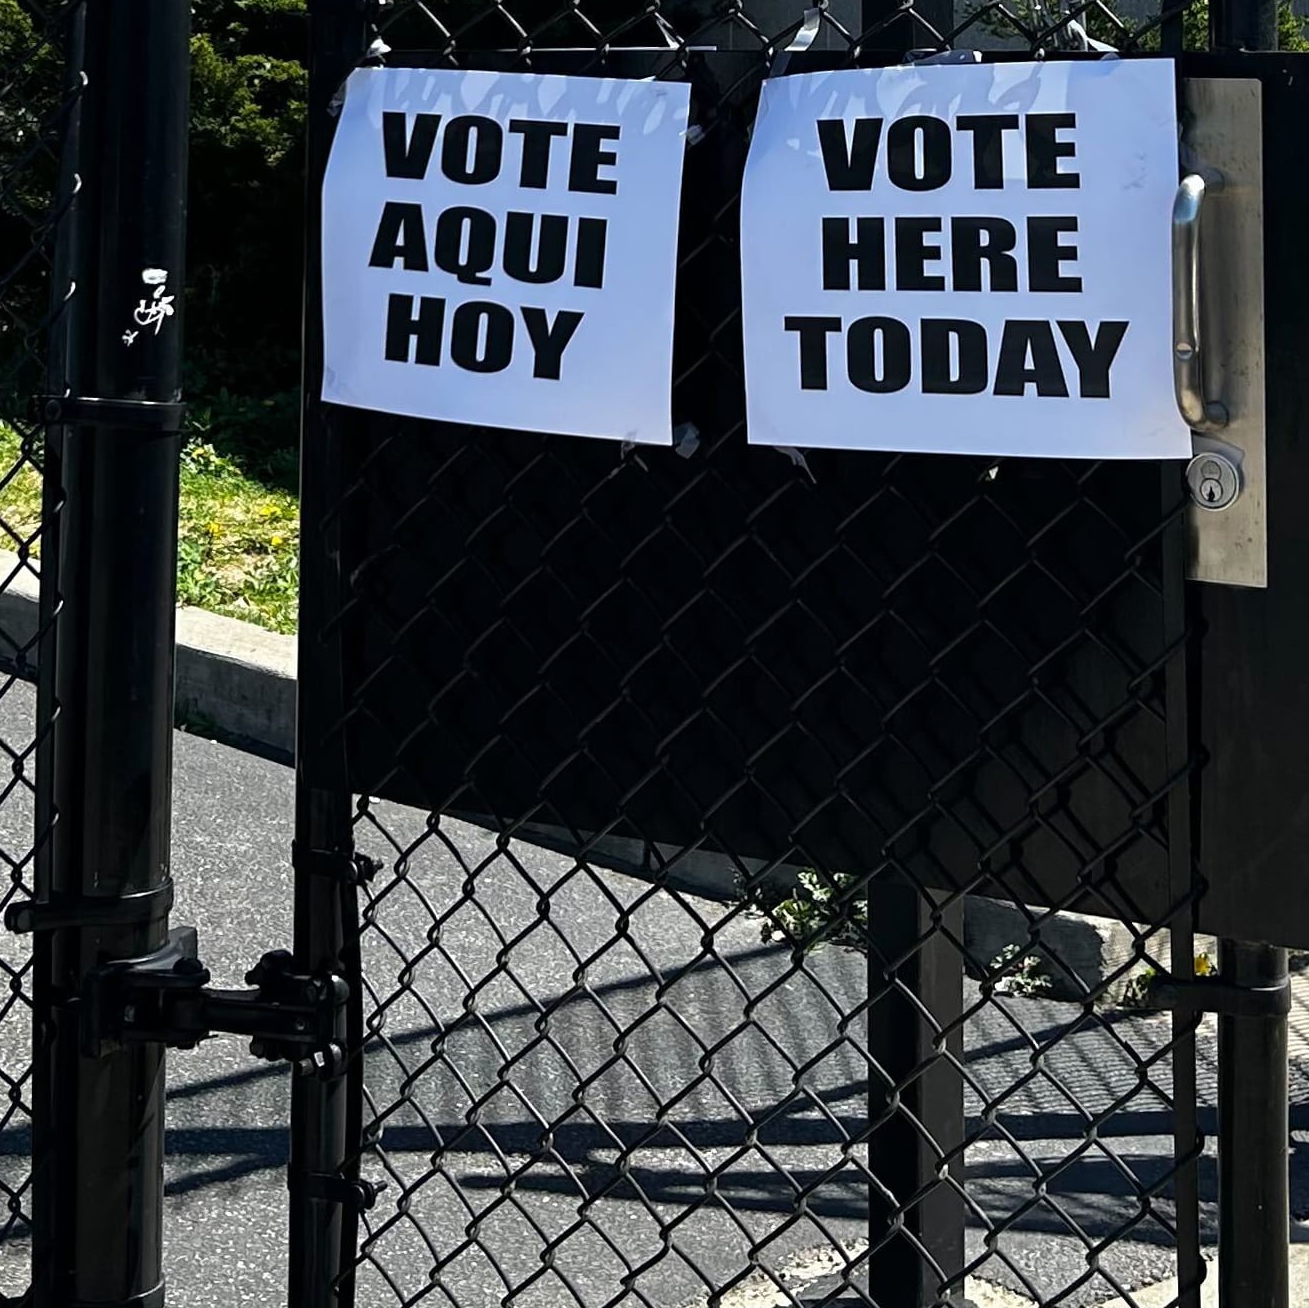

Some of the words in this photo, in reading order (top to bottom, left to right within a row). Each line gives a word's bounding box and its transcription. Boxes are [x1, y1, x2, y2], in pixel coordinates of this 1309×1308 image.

[382, 111, 622, 196] VOTE
[816, 112, 1081, 192] VOTE
[368, 201, 608, 290] AQUI
[821, 216, 1083, 293] HERE
[384, 293, 585, 381] HOY
[784, 316, 1130, 399] TODAY
